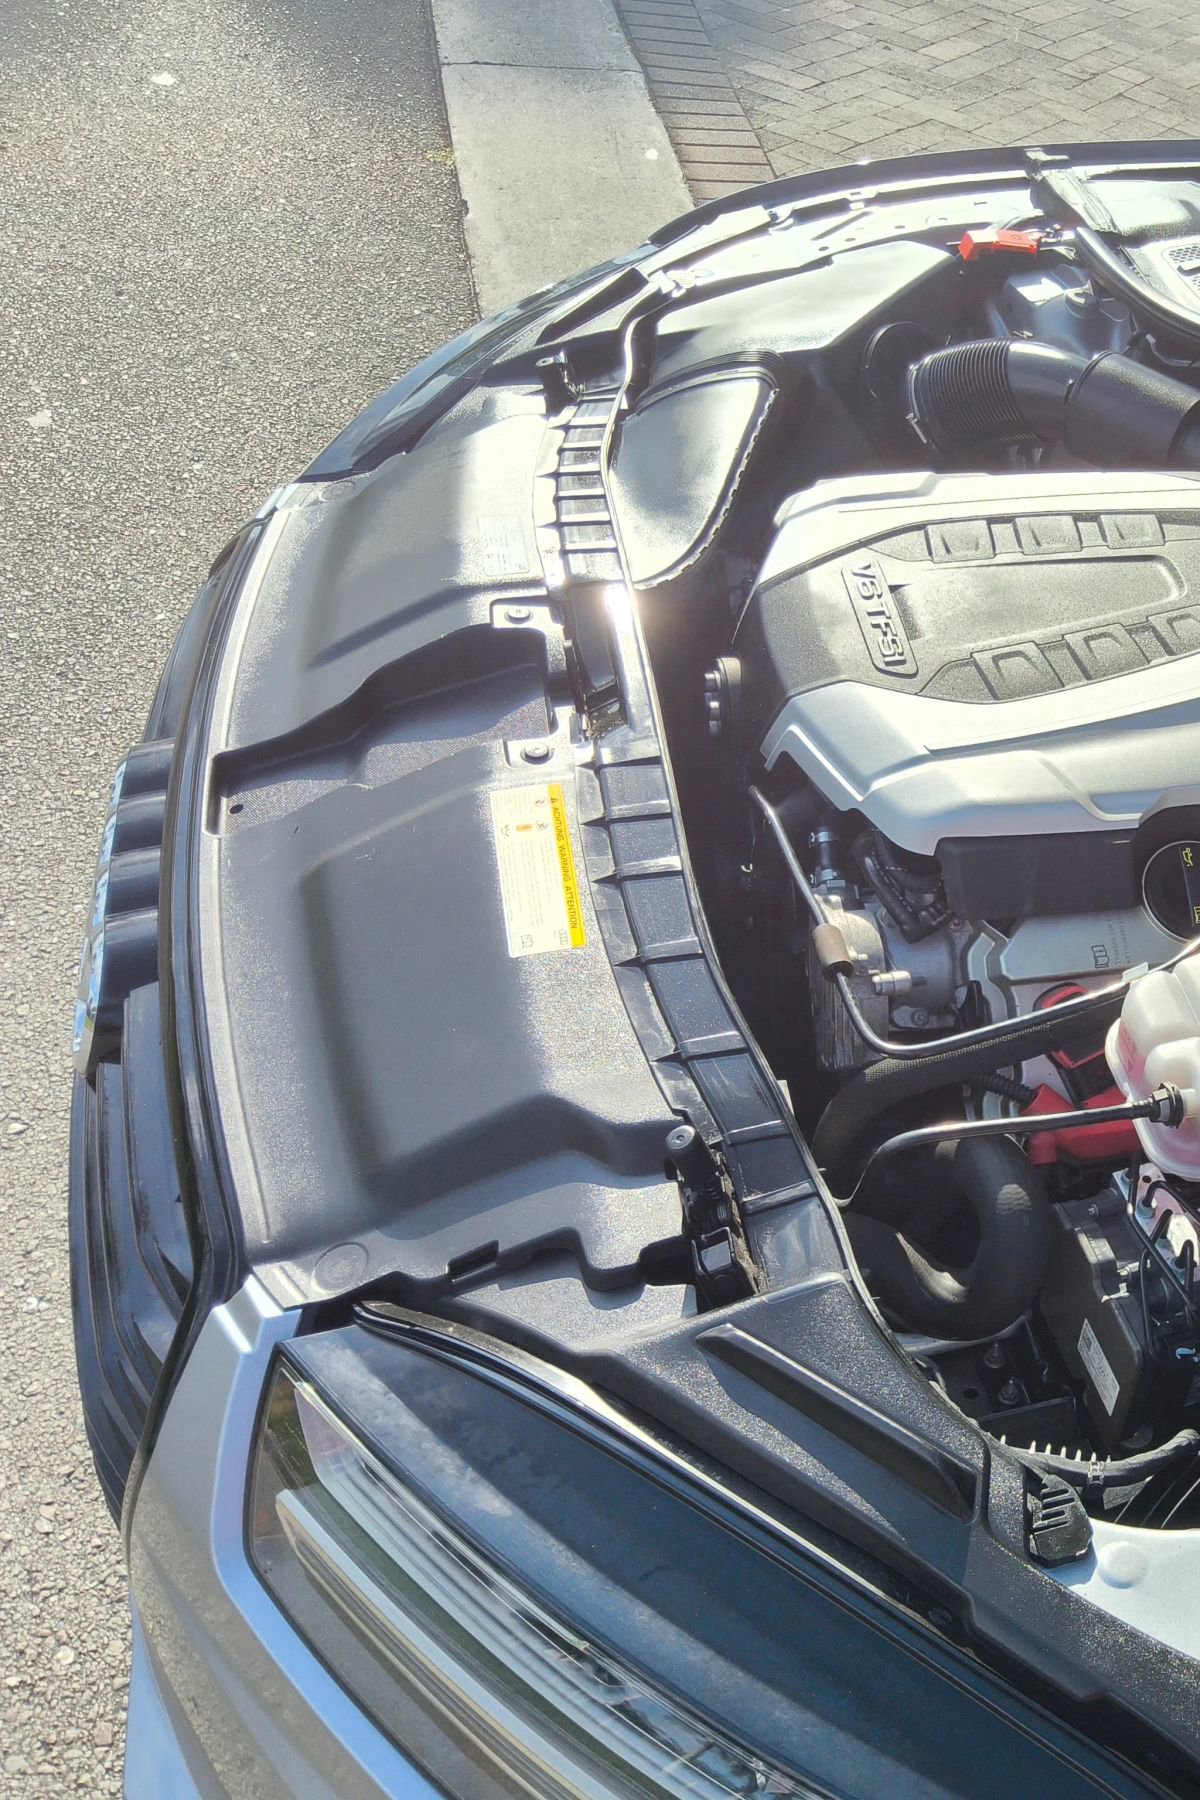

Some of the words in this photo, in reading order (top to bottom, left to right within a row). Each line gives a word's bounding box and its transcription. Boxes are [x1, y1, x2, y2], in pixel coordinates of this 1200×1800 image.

[851, 563, 883, 600] V6
[866, 601, 907, 667] TFSI
[553, 806, 564, 841] ACHTUNG
[559, 845, 571, 881] WARNING
[565, 886, 578, 929] ATTENTION
